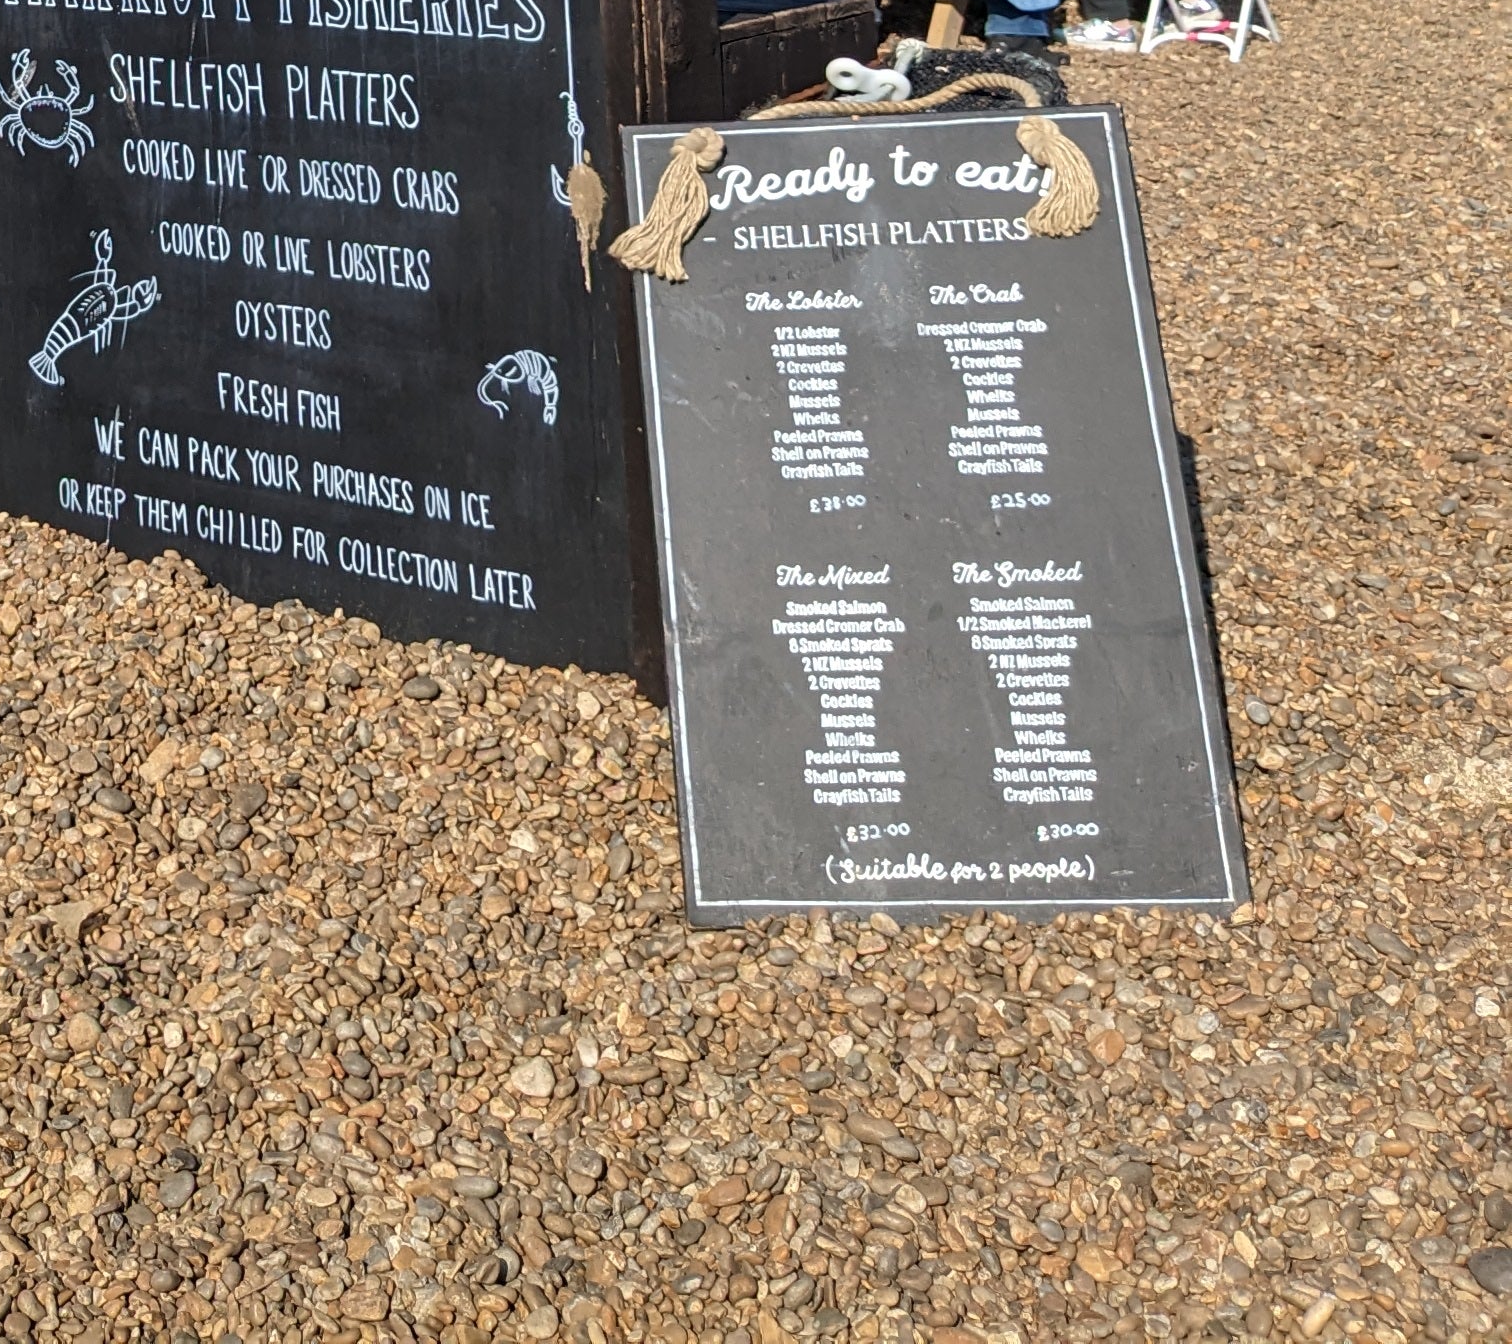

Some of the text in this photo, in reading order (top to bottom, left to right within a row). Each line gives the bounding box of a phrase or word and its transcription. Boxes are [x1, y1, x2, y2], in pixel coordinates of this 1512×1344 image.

[109, 53, 420, 130] SHELLFISH PLATTERS
[122, 139, 460, 215] COOKED LIVE OR DRESSED CRABS
[709, 144, 1054, 211] Ready to eat!
[733, 217, 1029, 250] SHELLFISH PLATTERS
[159, 221, 431, 292] COOKED OR LIVE LOBSTERS
[746, 289, 864, 311] The Lobster
[928, 282, 1025, 305] The Crab
[235, 300, 332, 351] OYSTERS
[795, 325, 841, 339] Lobster
[770, 341, 848, 357] 2 NZ Mussels
[776, 360, 846, 374] 2 Crevettes
[788, 377, 839, 391] Cockles
[217, 372, 342, 433] FRESH FISH
[788, 394, 842, 409] Mussels
[792, 411, 841, 426] Whelks
[773, 429, 865, 444] Peeled Prawns
[771, 445, 870, 462] Shell on Prawns
[93, 416, 495, 531] WE CAN PACK YOUR PURCHASES ON ICE
[781, 462, 865, 479] Crayfish Tails
[58, 476, 536, 612] OR KEEP THEM CHILLED FOR COLLECTION LATER
[776, 563, 890, 590] The Mixed
[952, 560, 1083, 588] The Smoked
[825, 853, 1095, 884] (Suitable for 2 people)
